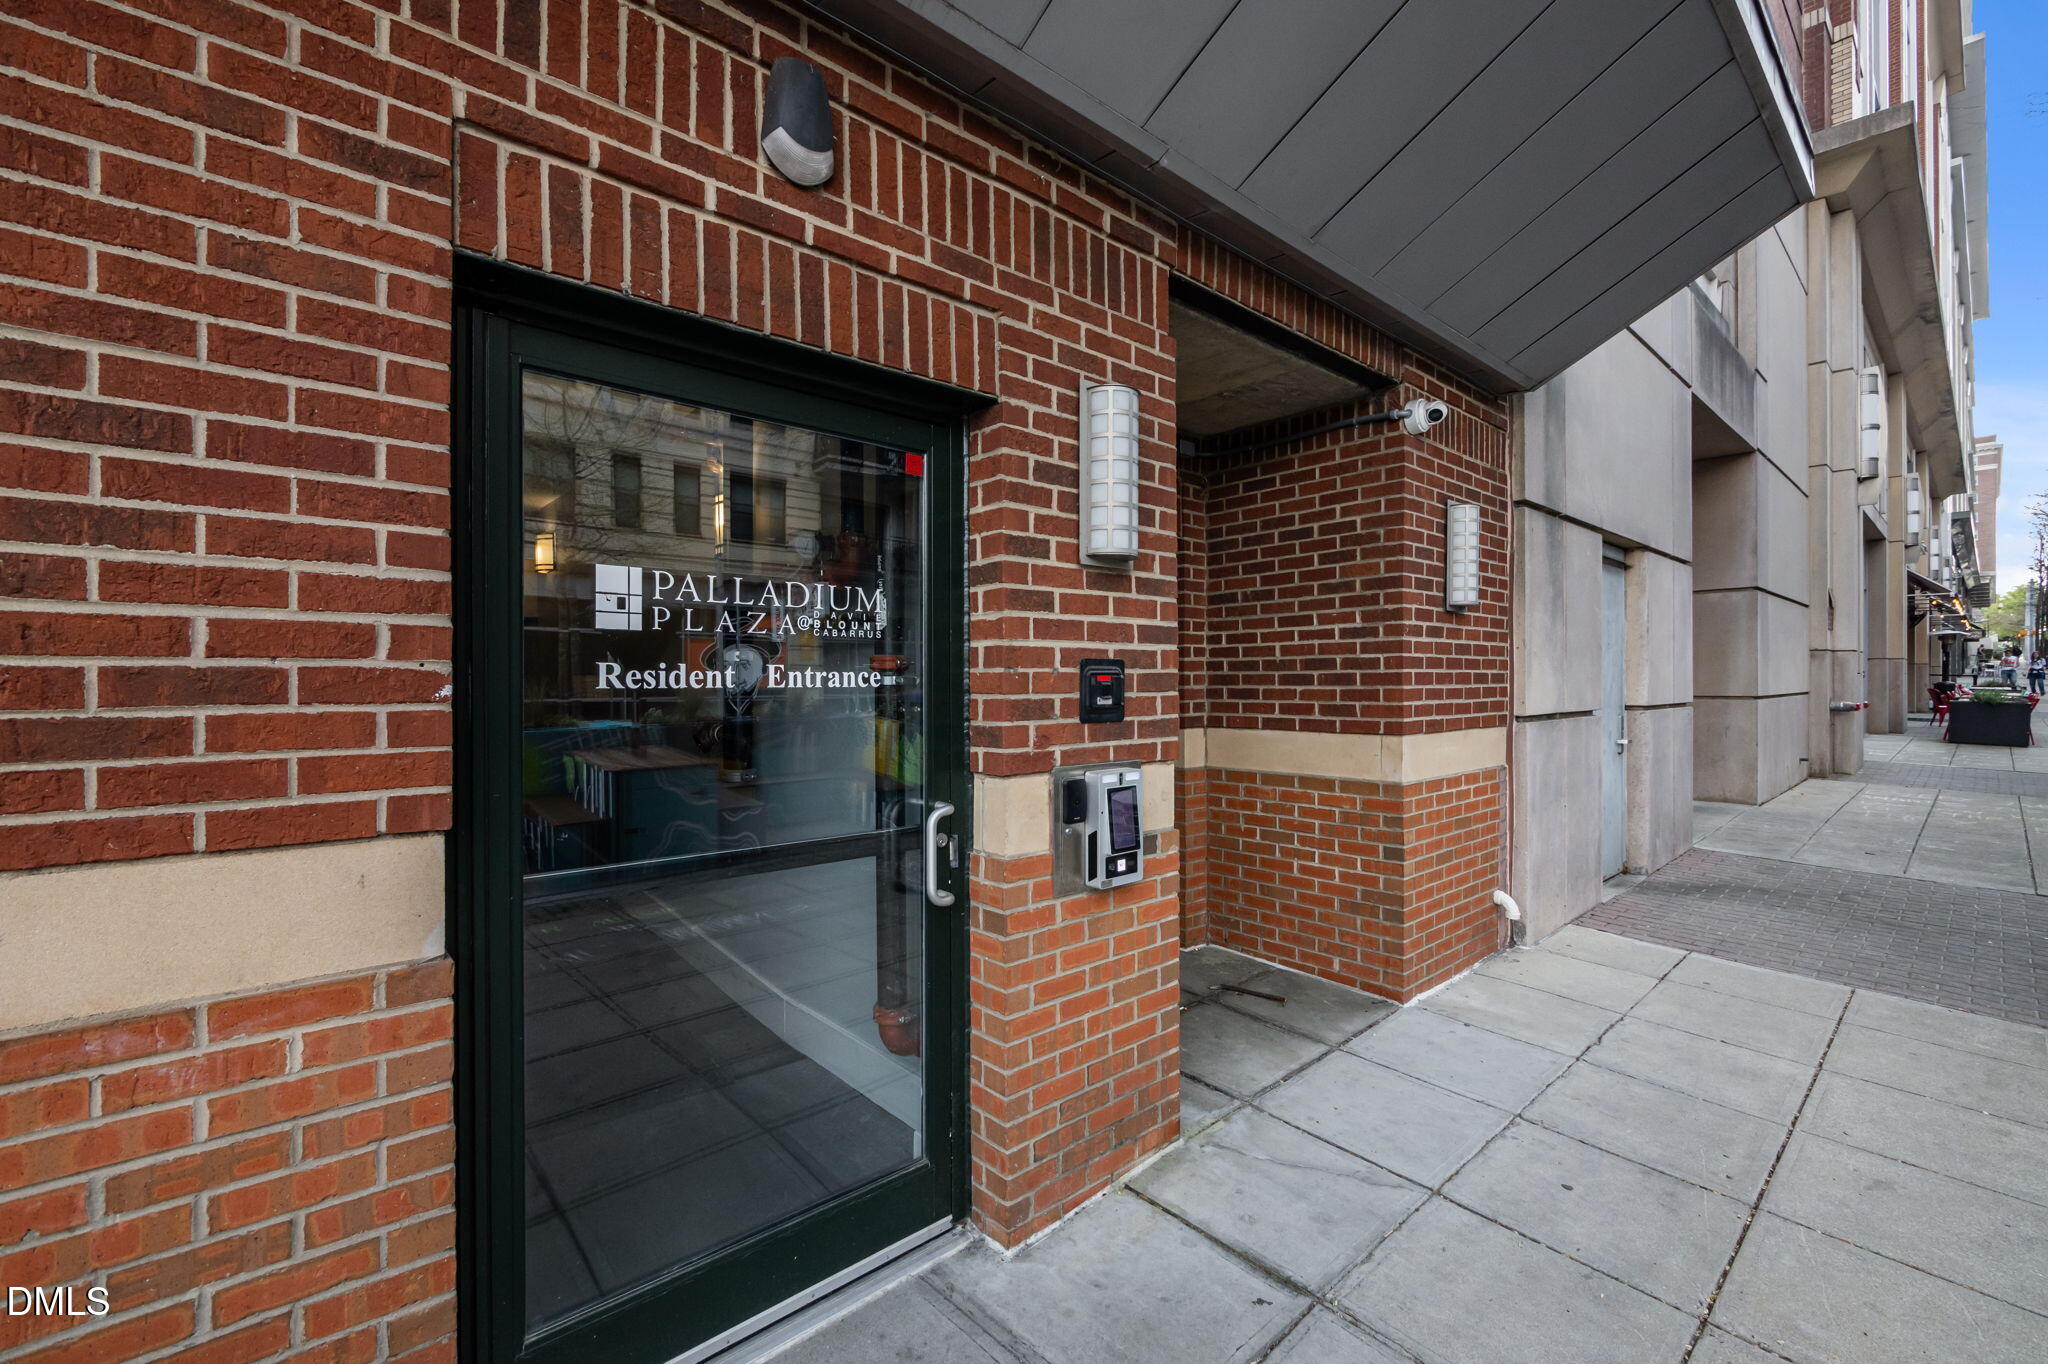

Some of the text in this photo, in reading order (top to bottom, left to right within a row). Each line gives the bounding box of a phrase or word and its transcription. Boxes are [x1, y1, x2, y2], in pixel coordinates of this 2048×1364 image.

[652, 569, 883, 613] PALLADIUM
[813, 610, 881, 622] DAVIE
[813, 620, 882, 631] BLOUNT
[813, 628, 882, 639] CABARRUS
[595, 661, 882, 690] Resident Entrance
